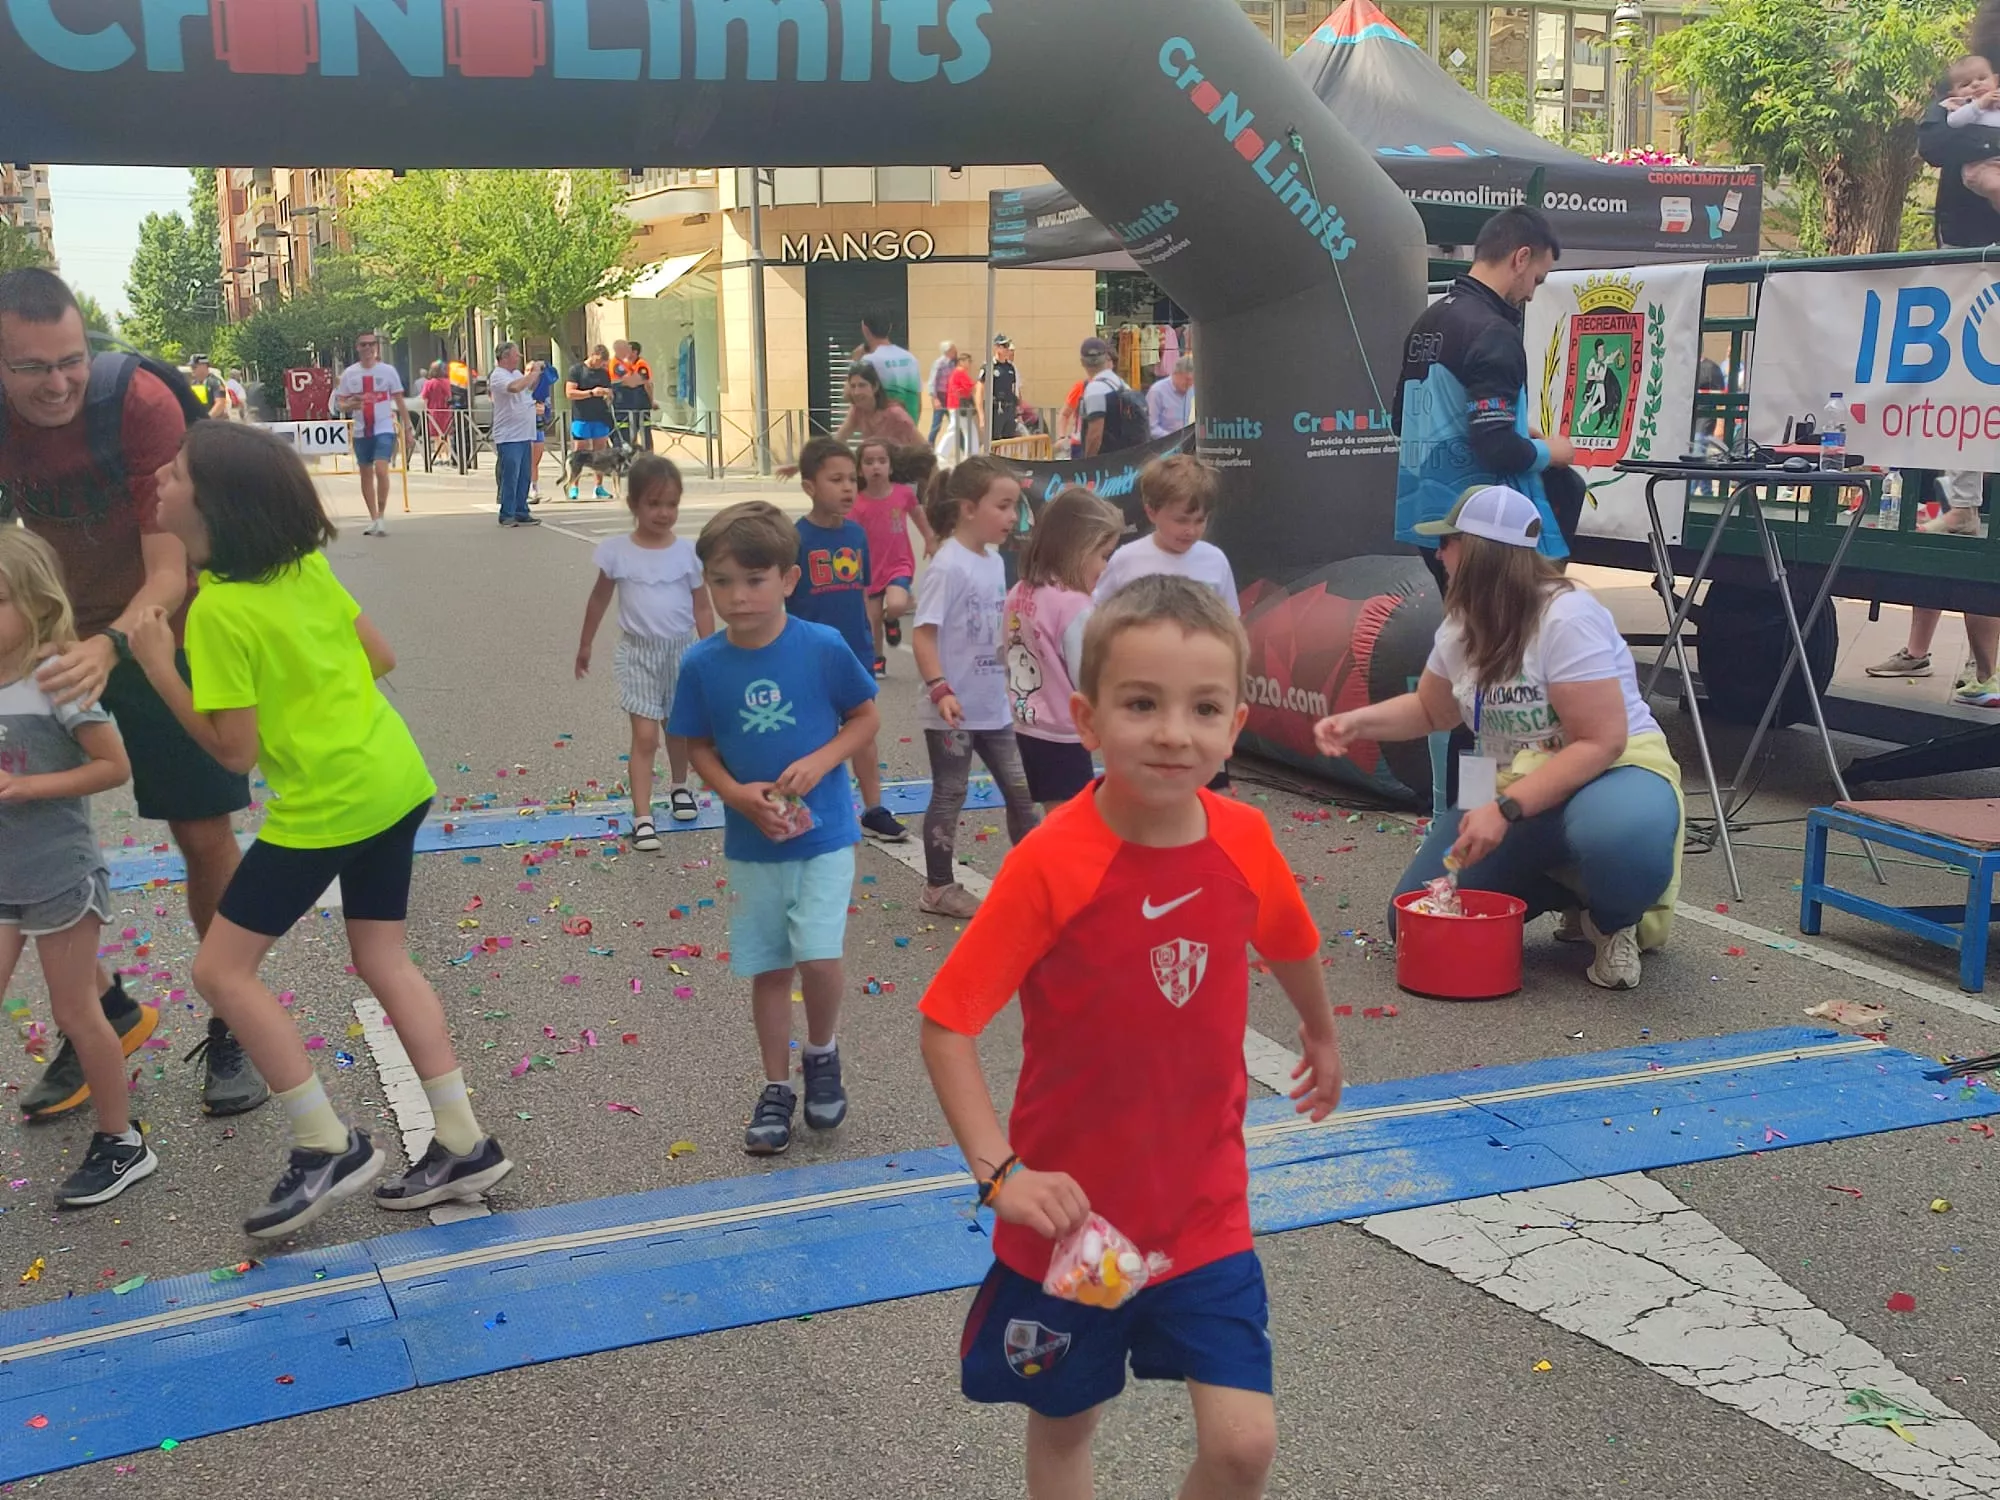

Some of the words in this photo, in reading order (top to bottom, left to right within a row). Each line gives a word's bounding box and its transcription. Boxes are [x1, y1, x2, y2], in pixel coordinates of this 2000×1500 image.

[1648, 172, 1728, 185] CRONOLIMITS
[1730, 174, 1757, 186] LIVE
[781, 229, 935, 263] MANGO
[1577, 316, 1638, 331] RECREATIVA
[302, 425, 346, 445] 10K
[1576, 438, 1613, 448] HUESCA
